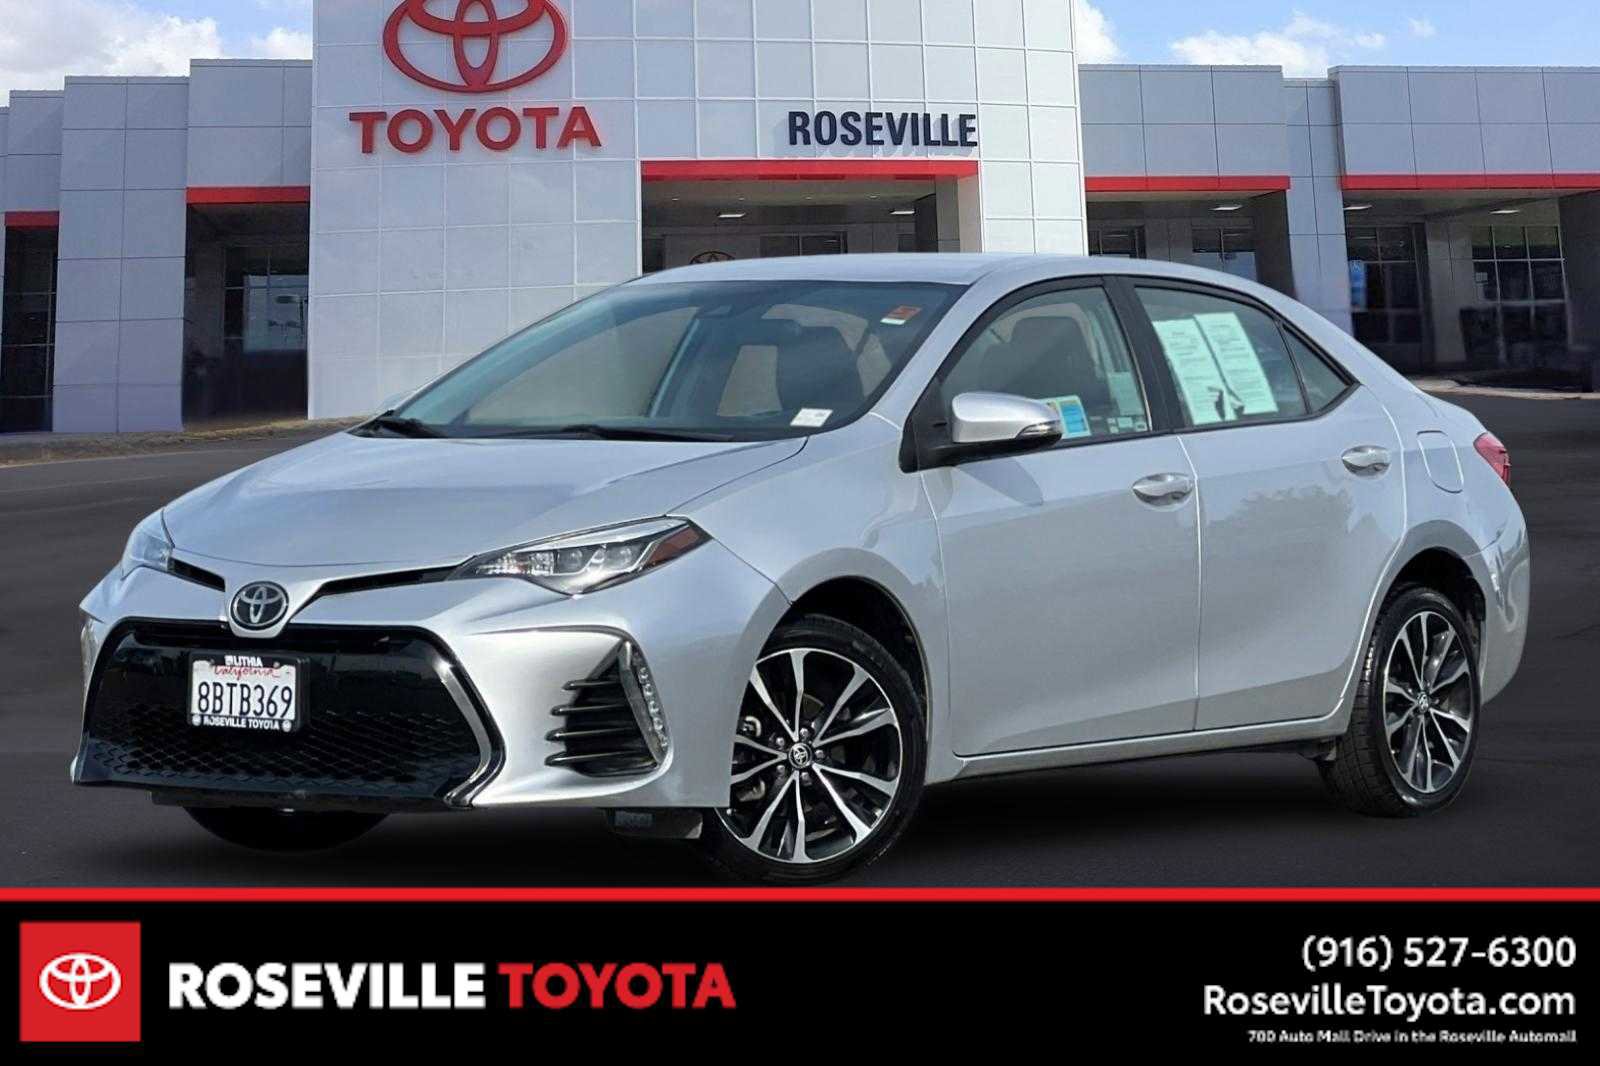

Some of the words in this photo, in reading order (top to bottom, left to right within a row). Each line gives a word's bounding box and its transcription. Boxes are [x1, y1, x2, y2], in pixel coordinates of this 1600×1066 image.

[349, 106, 602, 153] TOYOTA
[788, 111, 978, 147] ROSEVILLE
[198, 681, 292, 718] 8BTB369
[203, 716, 247, 728] ROSEVILLE
[248, 719, 280, 731] TOYOTA
